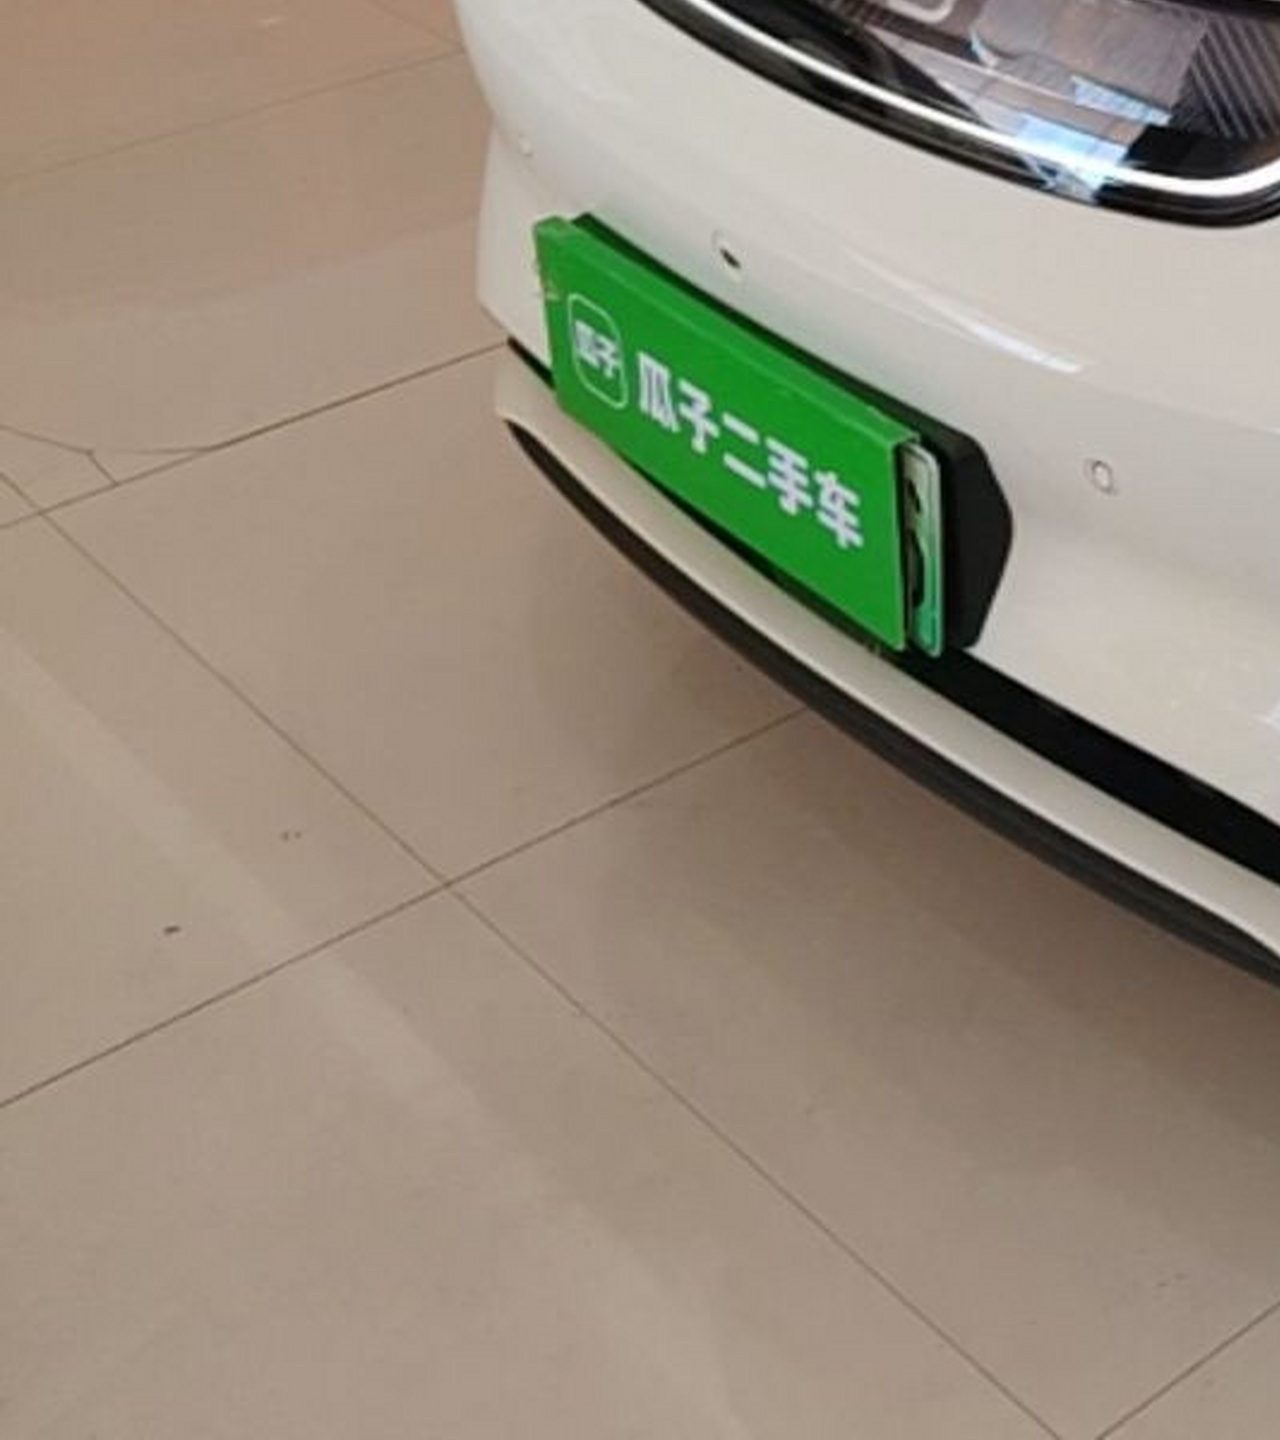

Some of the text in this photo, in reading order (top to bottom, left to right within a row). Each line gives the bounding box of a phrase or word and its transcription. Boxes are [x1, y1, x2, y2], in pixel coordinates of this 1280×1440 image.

[637, 350, 864, 549] 瓜子二手车
